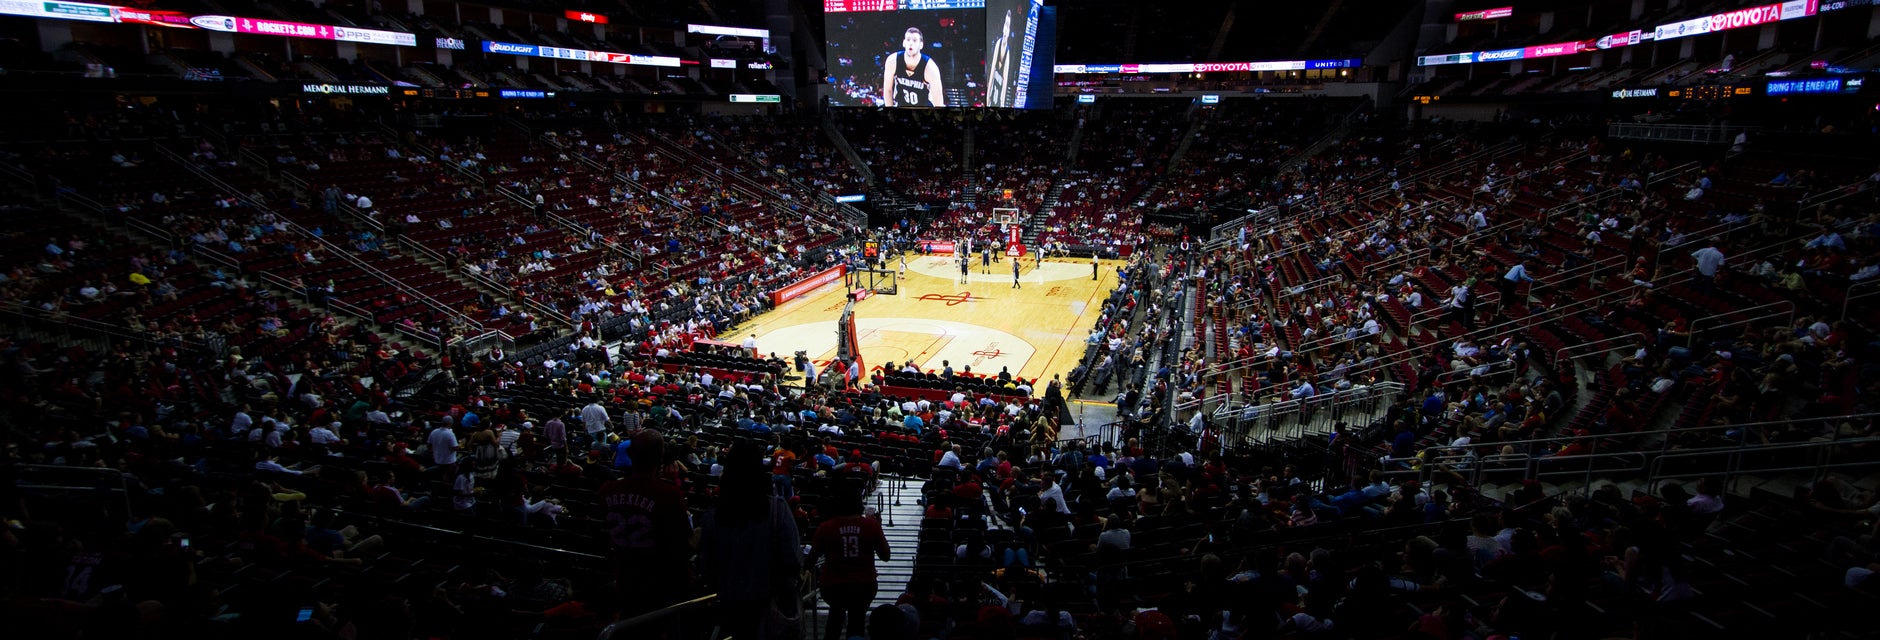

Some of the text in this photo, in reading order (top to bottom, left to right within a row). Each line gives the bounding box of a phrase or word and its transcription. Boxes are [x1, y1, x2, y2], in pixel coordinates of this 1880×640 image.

[1725, 5, 1780, 28] TOYOTA
[256, 21, 316, 36] ROCKETS.COM
[346, 31, 371, 41] PPS
[494, 43, 510, 52] BUD
[510, 45, 533, 54] LIGHT
[1482, 52, 1501, 60] BUD
[1500, 50, 1520, 58] LIGHT
[748, 61, 766, 69] reliant
[1206, 62, 1249, 72] TOYOTA
[303, 83, 389, 94] MEMORIAL HERMANN
[897, 77, 925, 90] MEMPHIS
[1768, 80, 1839, 93] BRING THE ENERGY!
[902, 88, 919, 105] 30
[605, 493, 655, 513] DREXLER
[606, 511, 655, 549] 22
[841, 535, 859, 558] 13
